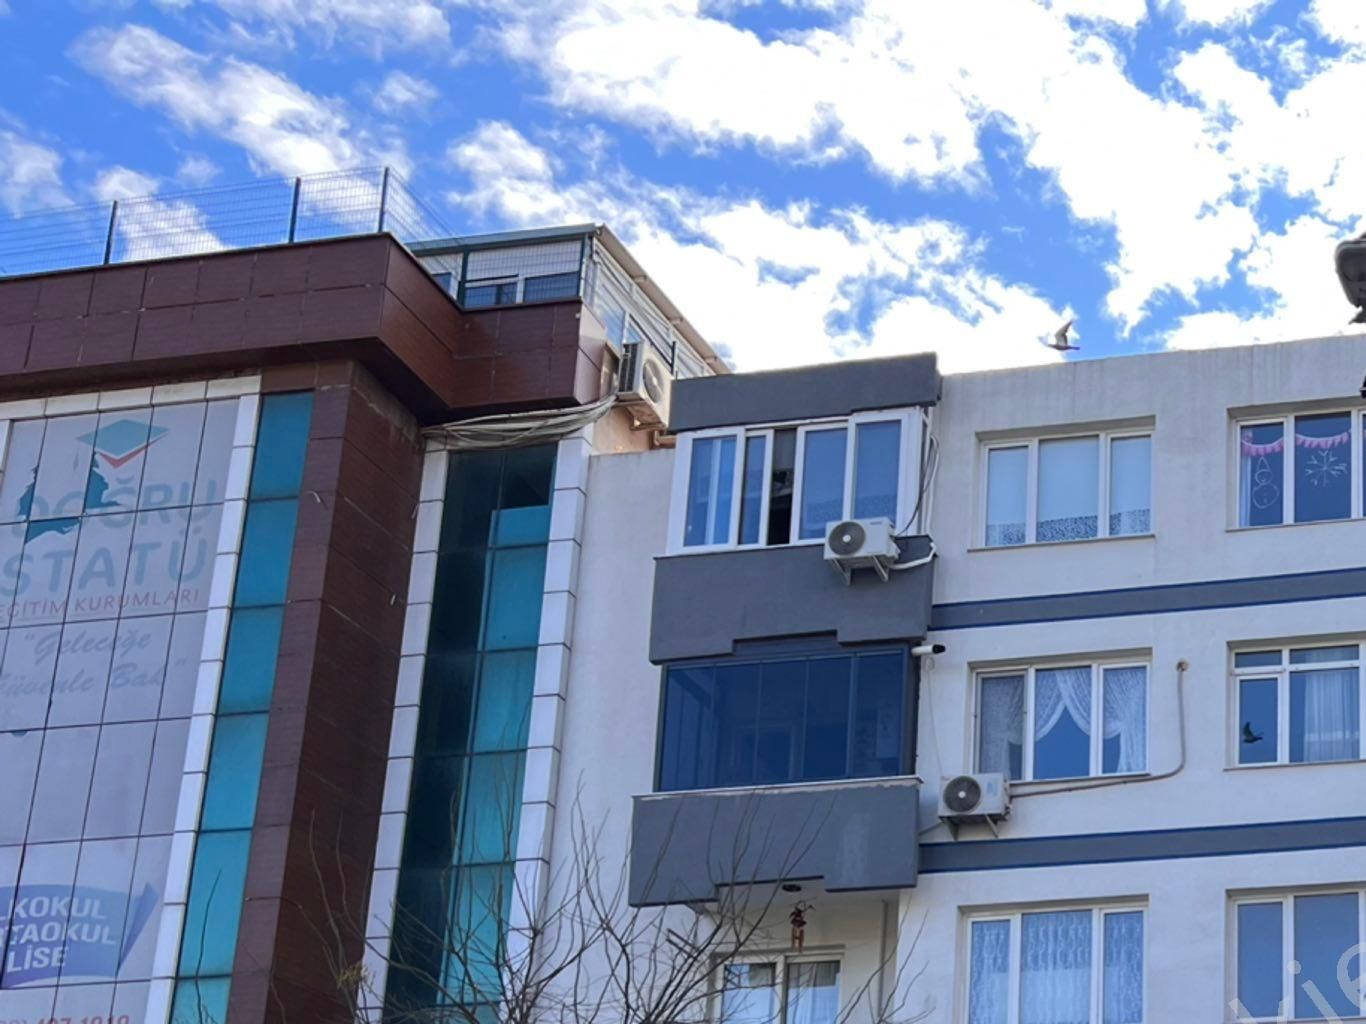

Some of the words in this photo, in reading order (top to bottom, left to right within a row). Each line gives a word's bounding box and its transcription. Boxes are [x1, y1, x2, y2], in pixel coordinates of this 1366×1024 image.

[0, 528, 208, 596] STATÜ
[75, 590, 200, 613] KURUMLARI
[7, 944, 68, 972] LİSE
